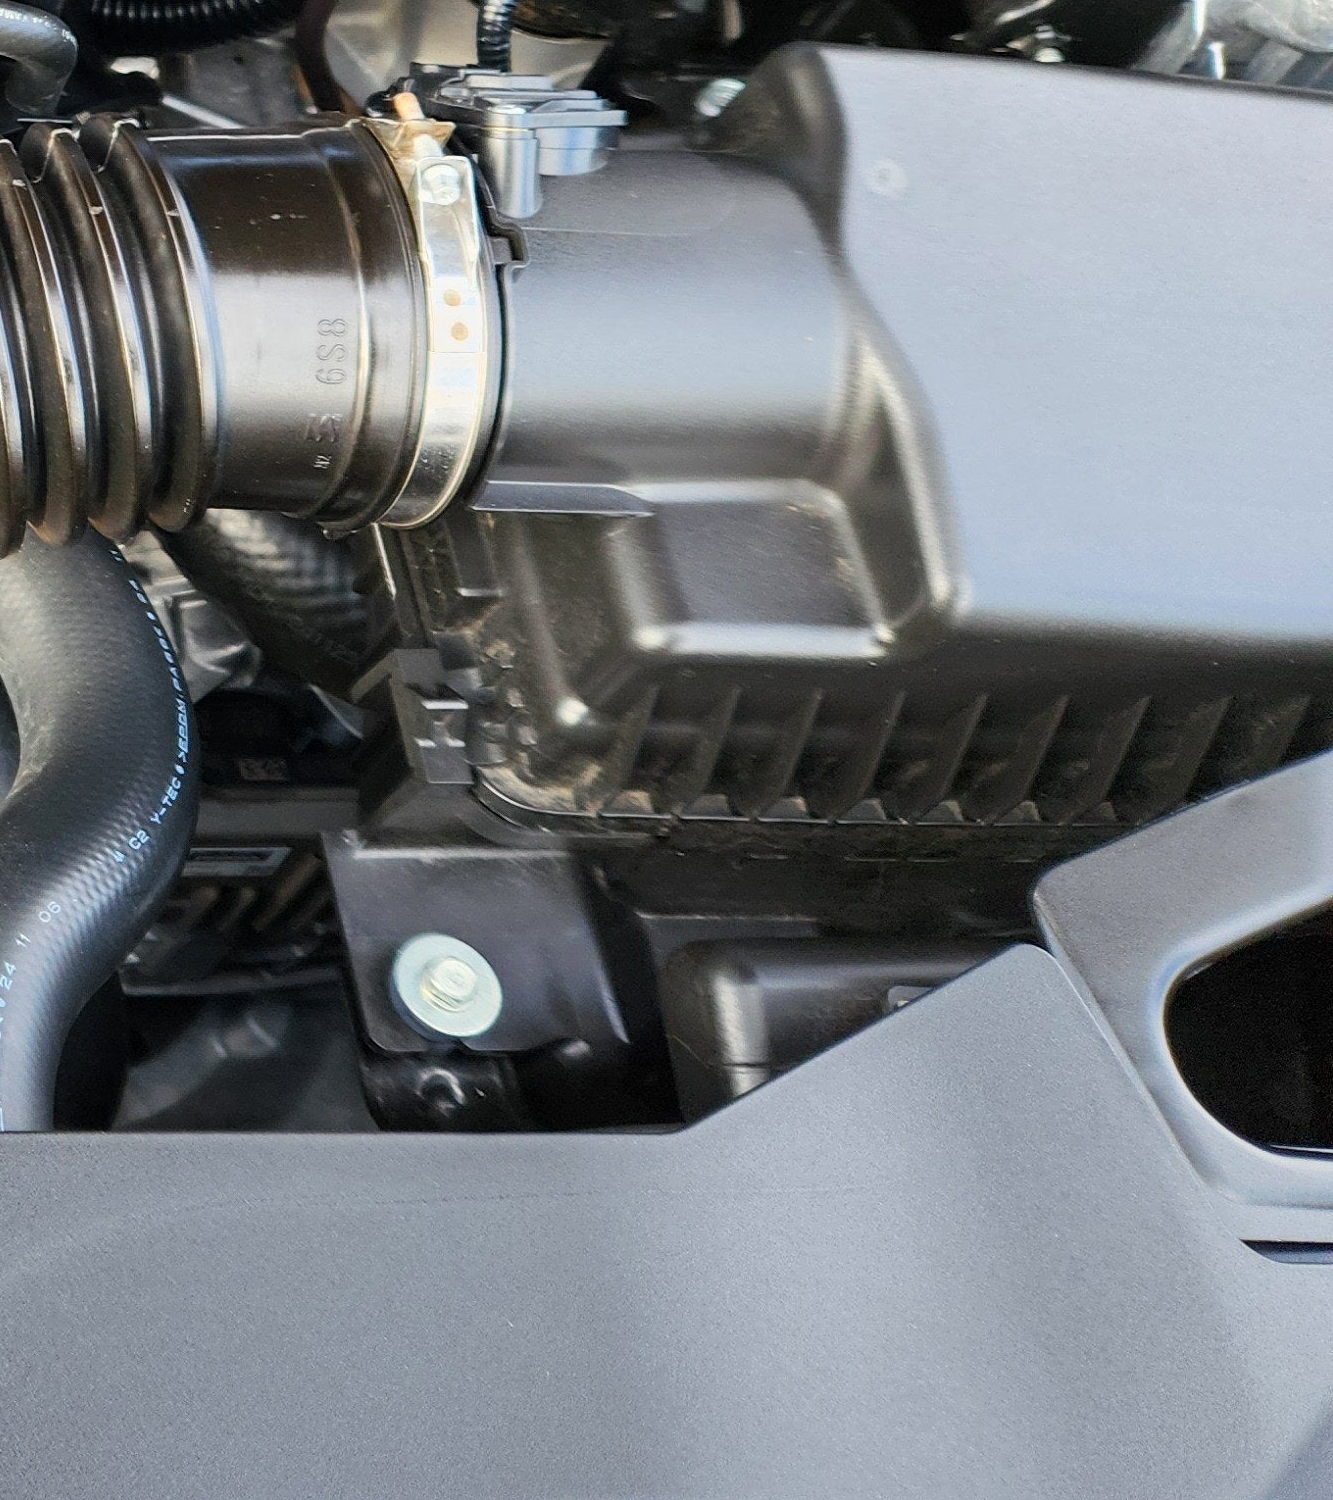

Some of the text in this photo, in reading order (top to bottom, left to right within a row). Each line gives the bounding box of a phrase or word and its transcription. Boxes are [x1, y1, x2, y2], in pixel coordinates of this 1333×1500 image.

[315, 318, 348, 385] 6S8
[129, 830, 151, 851] C2
[150, 777, 182, 825] Y-TEC
[15, 933, 31, 949] 11
[37, 901, 62, 924] 06
